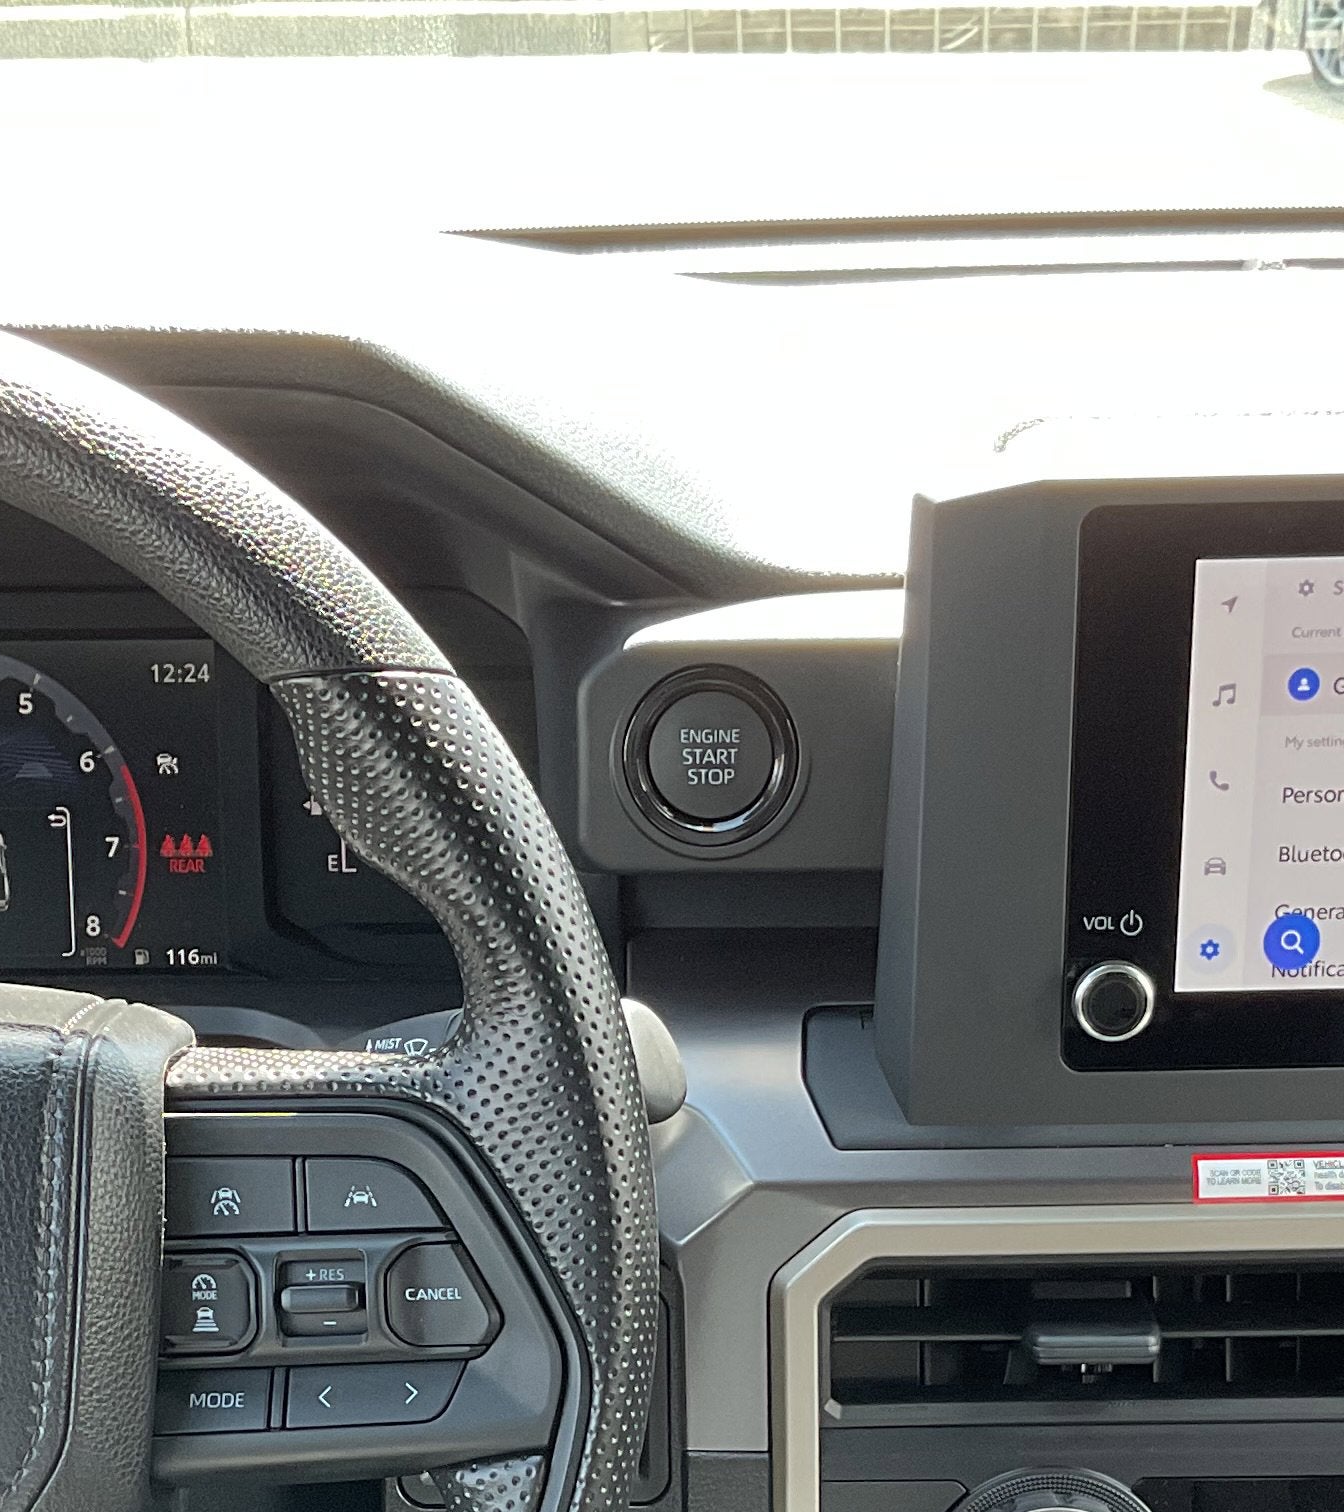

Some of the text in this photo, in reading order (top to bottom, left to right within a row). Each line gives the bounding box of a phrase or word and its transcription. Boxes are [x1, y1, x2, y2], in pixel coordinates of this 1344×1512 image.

[1291, 626, 1341, 639] Current
[150, 663, 210, 684] 12:24
[18, 693, 33, 715] 5
[680, 728, 741, 744] ENGINE
[1284, 735, 1304, 750] My
[79, 751, 95, 773] 6
[682, 748, 739, 765] START
[687, 768, 735, 786] STOP
[105, 836, 120, 858] 7
[169, 858, 206, 874] REAR
[327, 855, 338, 873] E
[85, 915, 101, 936] 8
[1083, 916, 1115, 931] VOL
[374, 1038, 403, 1051] MIST
[1313, 1168, 1338, 1179] health
[1314, 1180, 1324, 1191] To
[319, 1269, 345, 1281] RES
[191, 1290, 218, 1301] MODE
[404, 1287, 462, 1301] CANCEL
[189, 1392, 246, 1408] MODE
